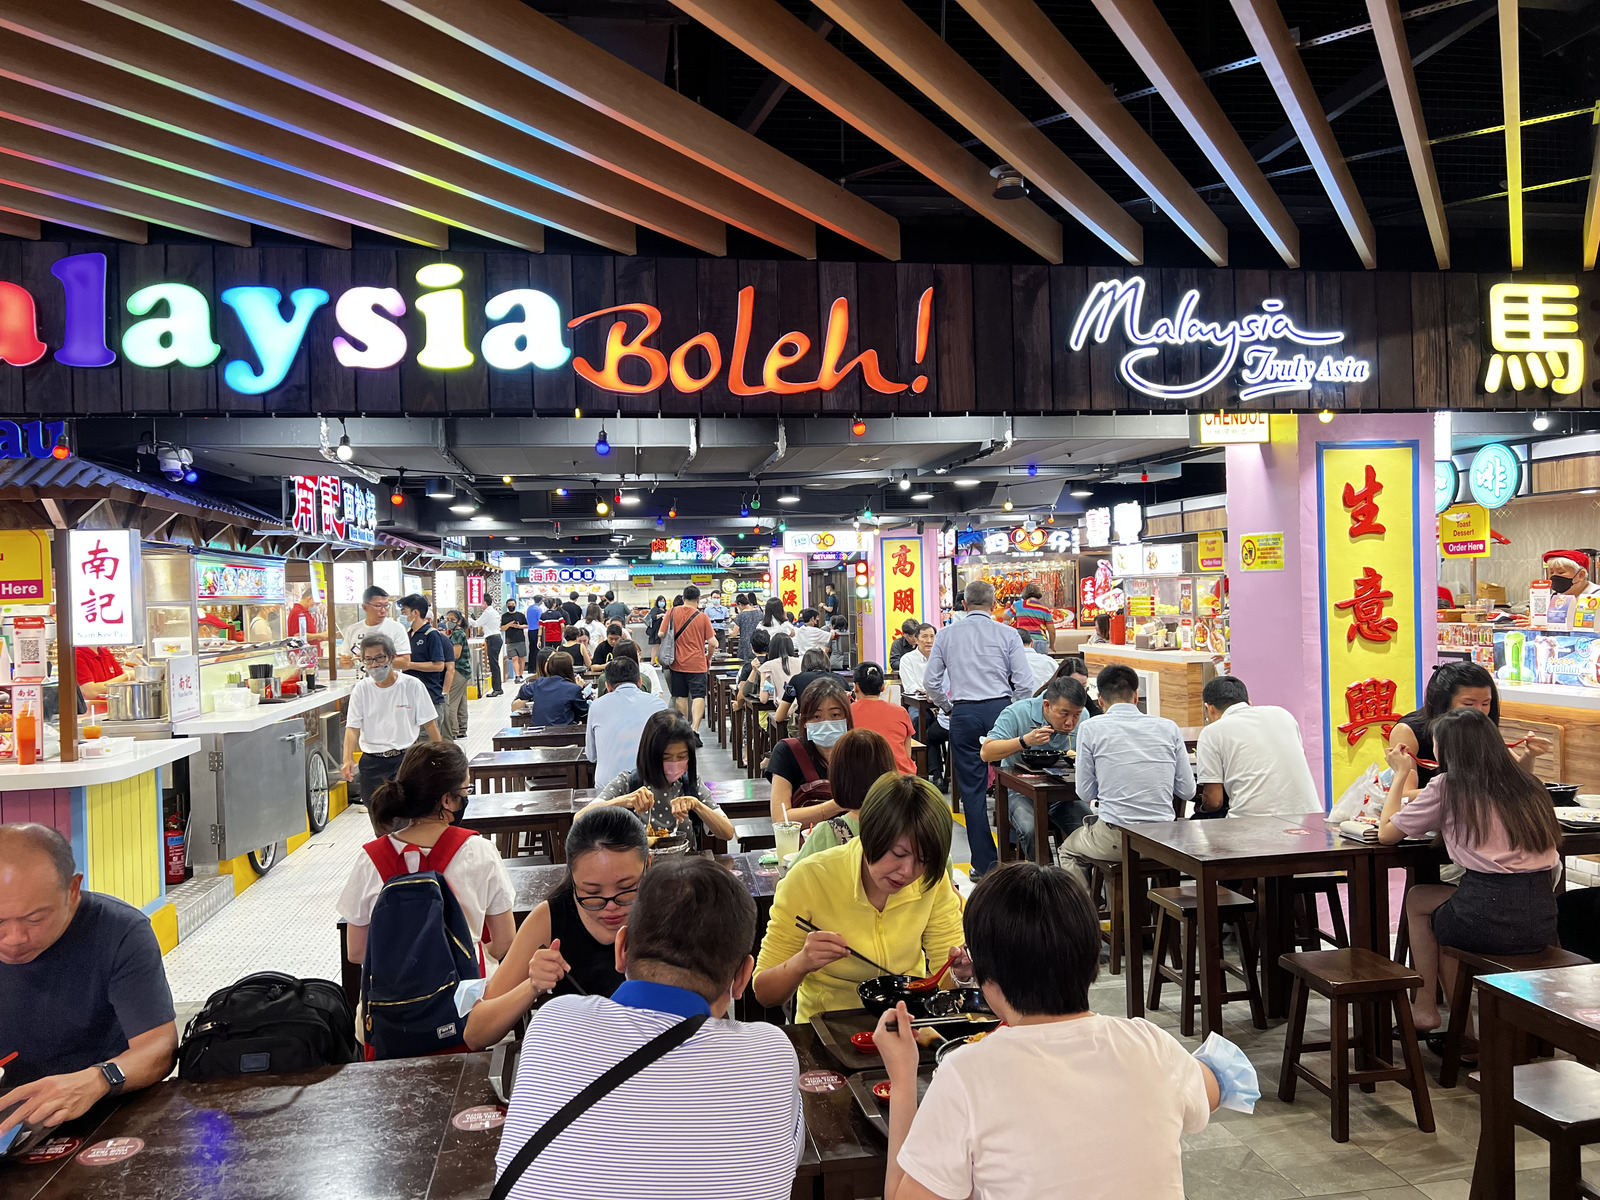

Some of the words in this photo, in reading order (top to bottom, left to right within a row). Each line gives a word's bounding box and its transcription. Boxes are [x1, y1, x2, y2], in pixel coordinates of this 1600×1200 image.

[1070, 275, 1344, 399] Malaysia
[1484, 283, 1584, 395] 馬
[1241, 346, 1317, 385] Truly
[1315, 356, 1370, 382] Asia
[1476, 456, 1507, 498] 啡
[1448, 543, 1467, 552] Order
[1468, 542, 1484, 551] Here
[1453, 529, 1475, 537] Dessert
[1, 583, 38, 595] Here
[81, 539, 124, 624] 南記
[892, 544, 915, 641] 高朋
